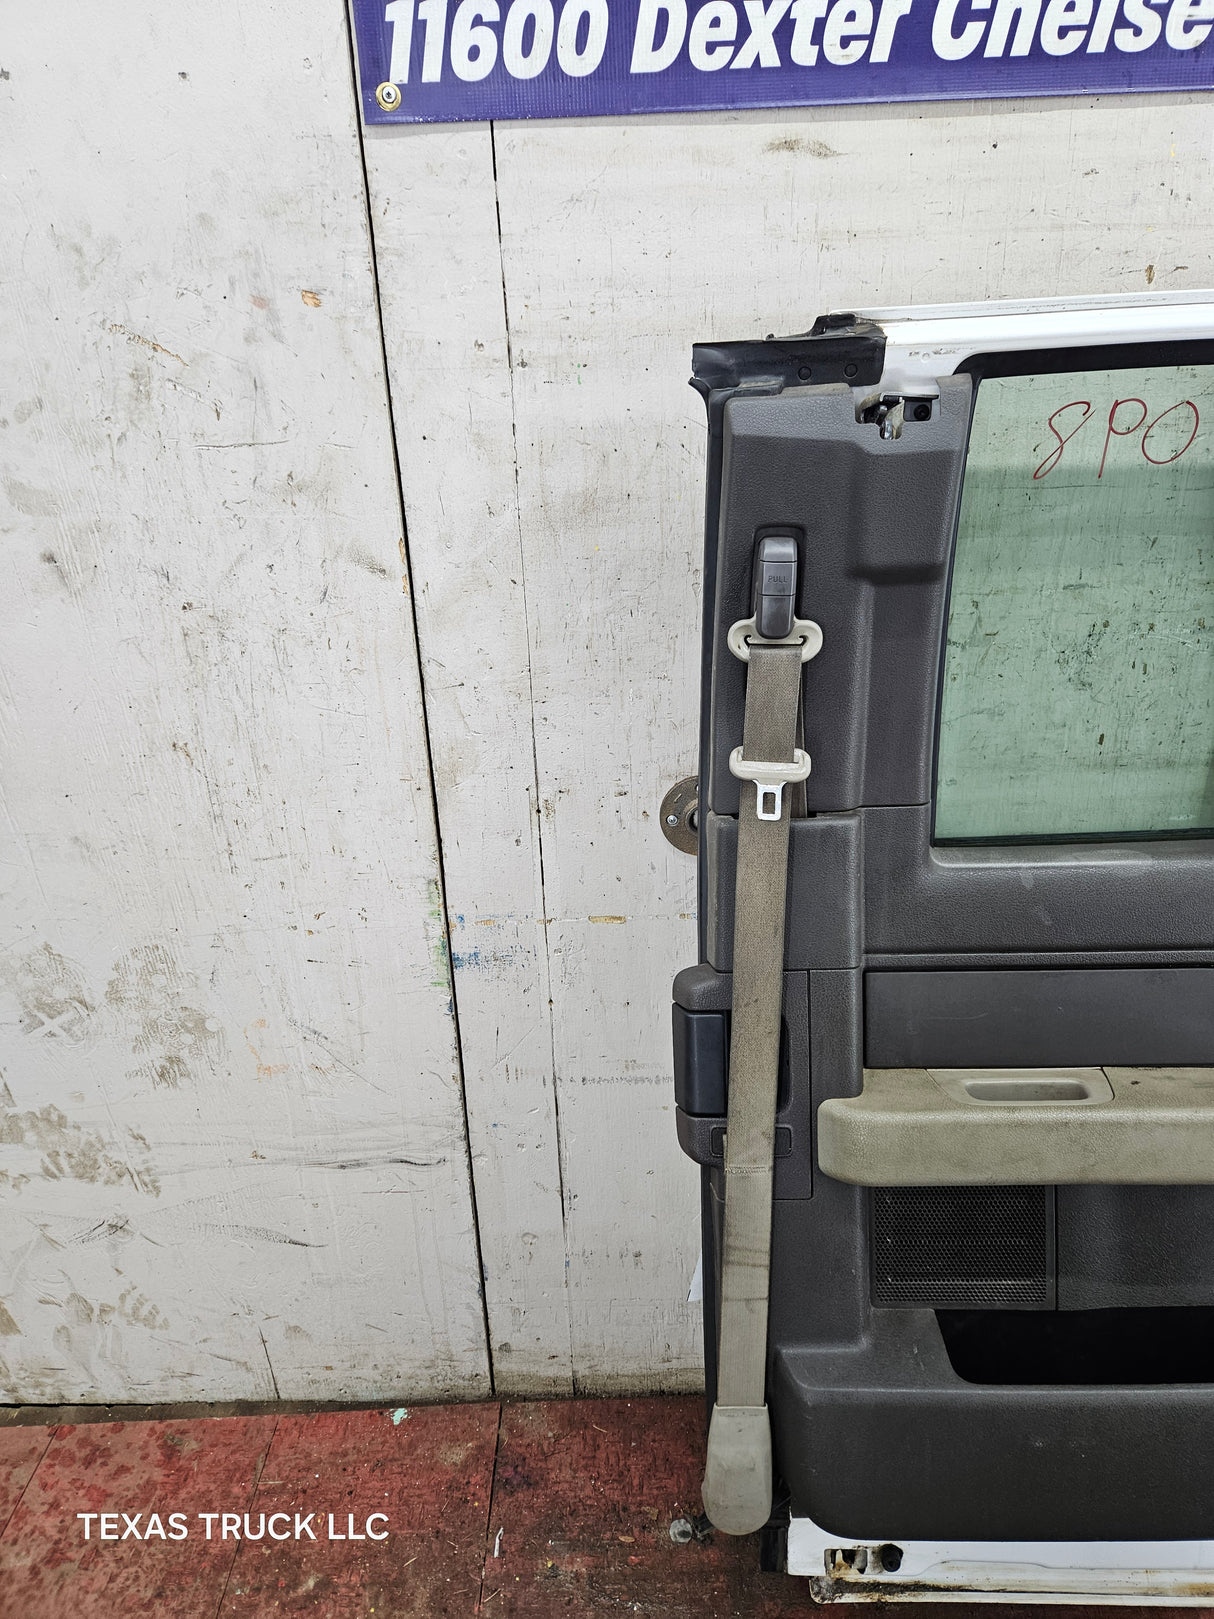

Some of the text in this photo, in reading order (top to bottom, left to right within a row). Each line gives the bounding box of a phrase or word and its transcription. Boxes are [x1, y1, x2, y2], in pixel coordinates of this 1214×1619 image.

[385, 0, 609, 84] 11600
[629, 0, 913, 73] Dexter
[767, 575, 788, 584] PULL
